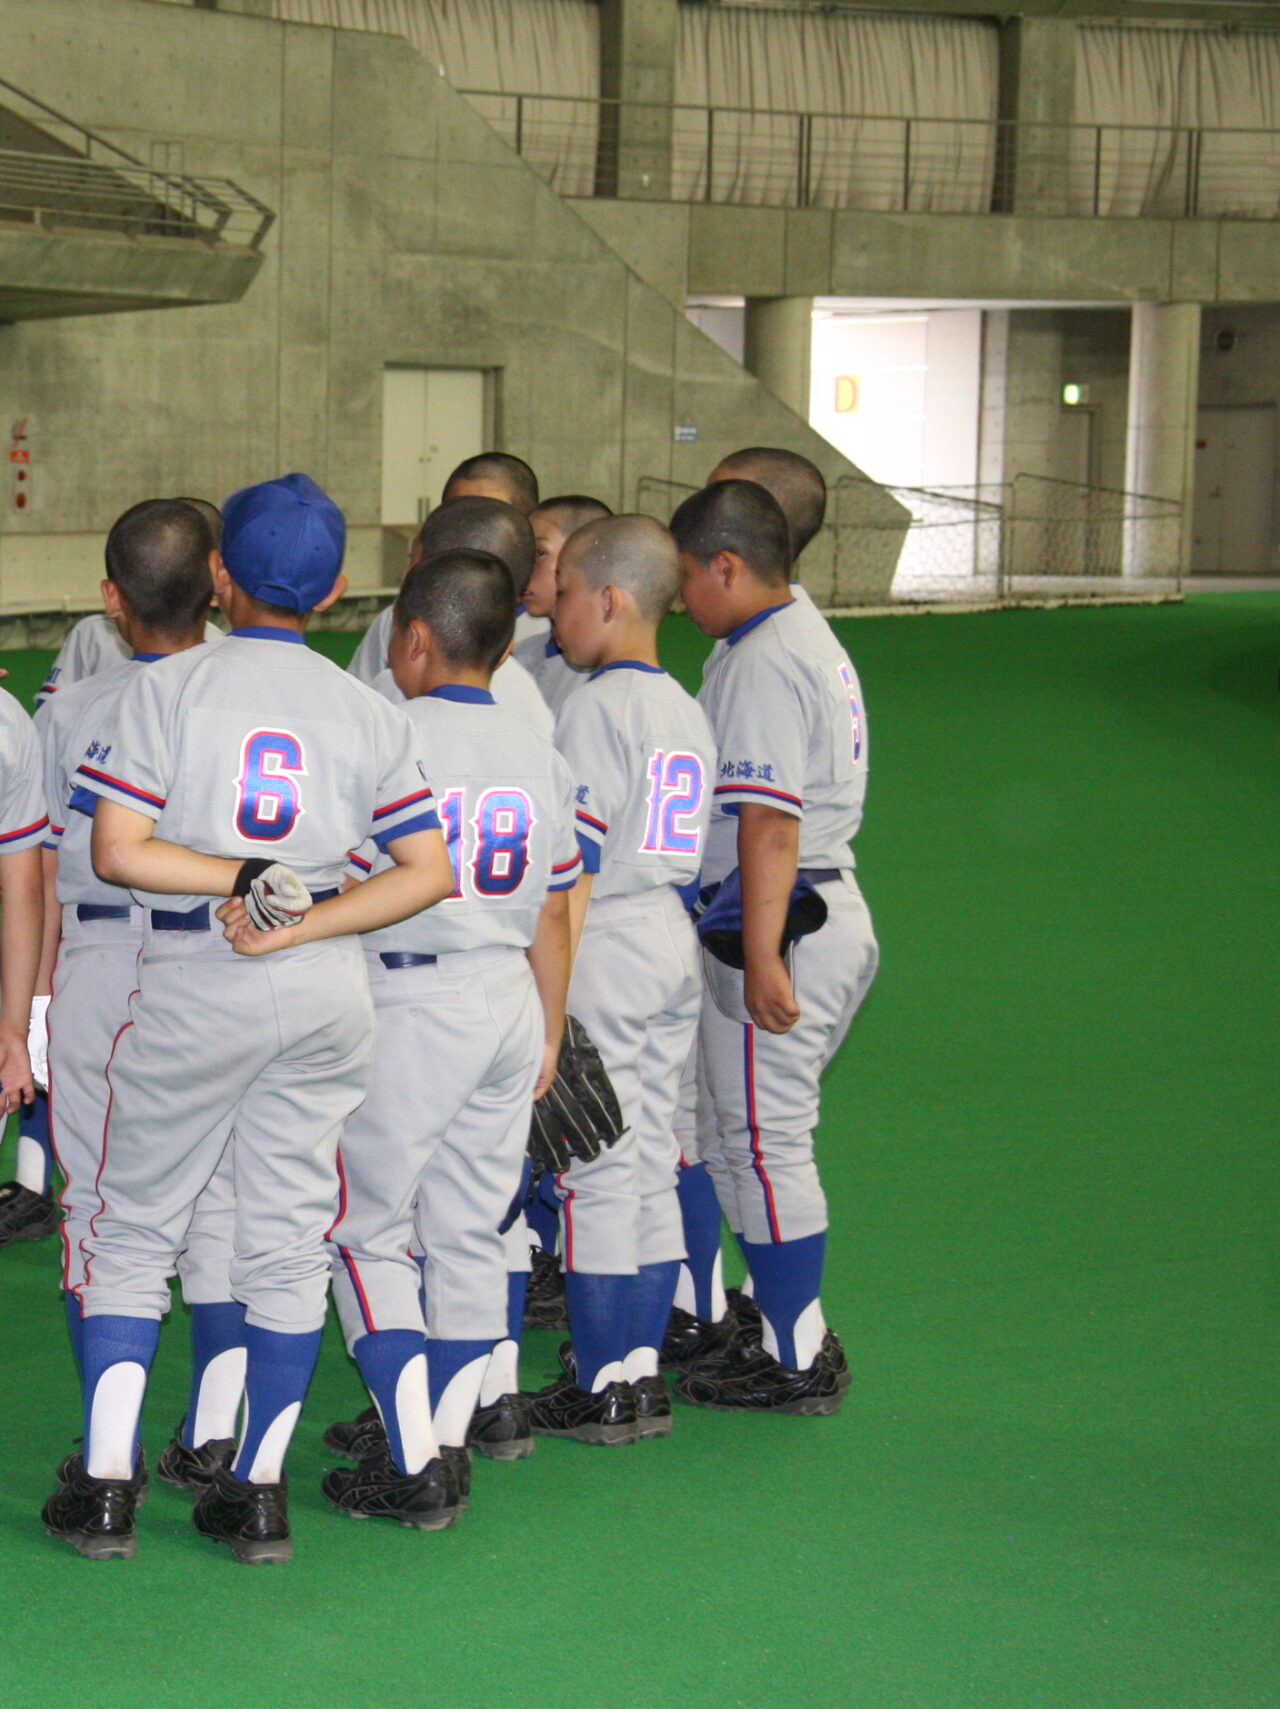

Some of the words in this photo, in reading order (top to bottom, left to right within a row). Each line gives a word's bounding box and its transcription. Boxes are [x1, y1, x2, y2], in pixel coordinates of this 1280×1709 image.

[834, 375, 859, 413] D
[232, 727, 309, 842] 6
[637, 748, 704, 856] 12
[719, 760, 776, 784] 北海道
[439, 787, 538, 902] 18
